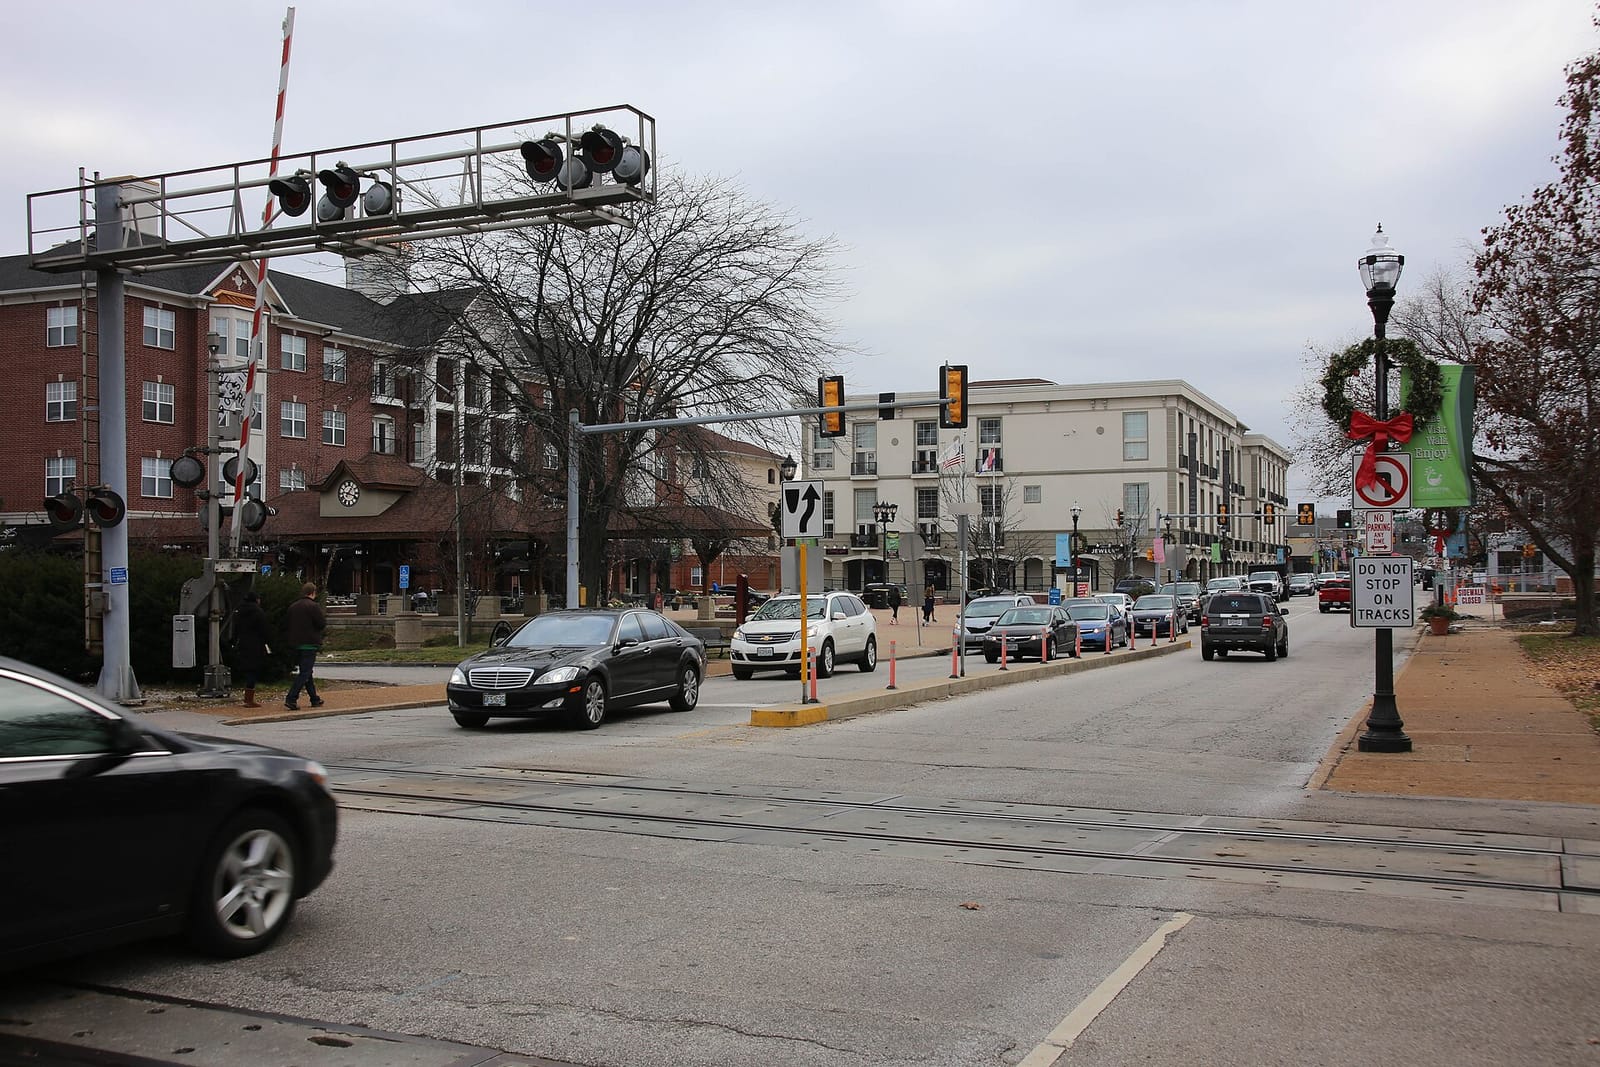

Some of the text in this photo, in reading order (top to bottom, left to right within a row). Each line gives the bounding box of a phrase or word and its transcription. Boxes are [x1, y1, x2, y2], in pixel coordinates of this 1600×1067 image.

[1426, 425, 1447, 435] Visit
[1373, 513, 1384, 522] NO
[1359, 564, 1408, 575] DO NOT
[1366, 579, 1401, 590] STOP
[1374, 594, 1393, 605] ON
[1462, 596, 1481, 604] CLOSED
[1358, 609, 1410, 620] TRACKS
